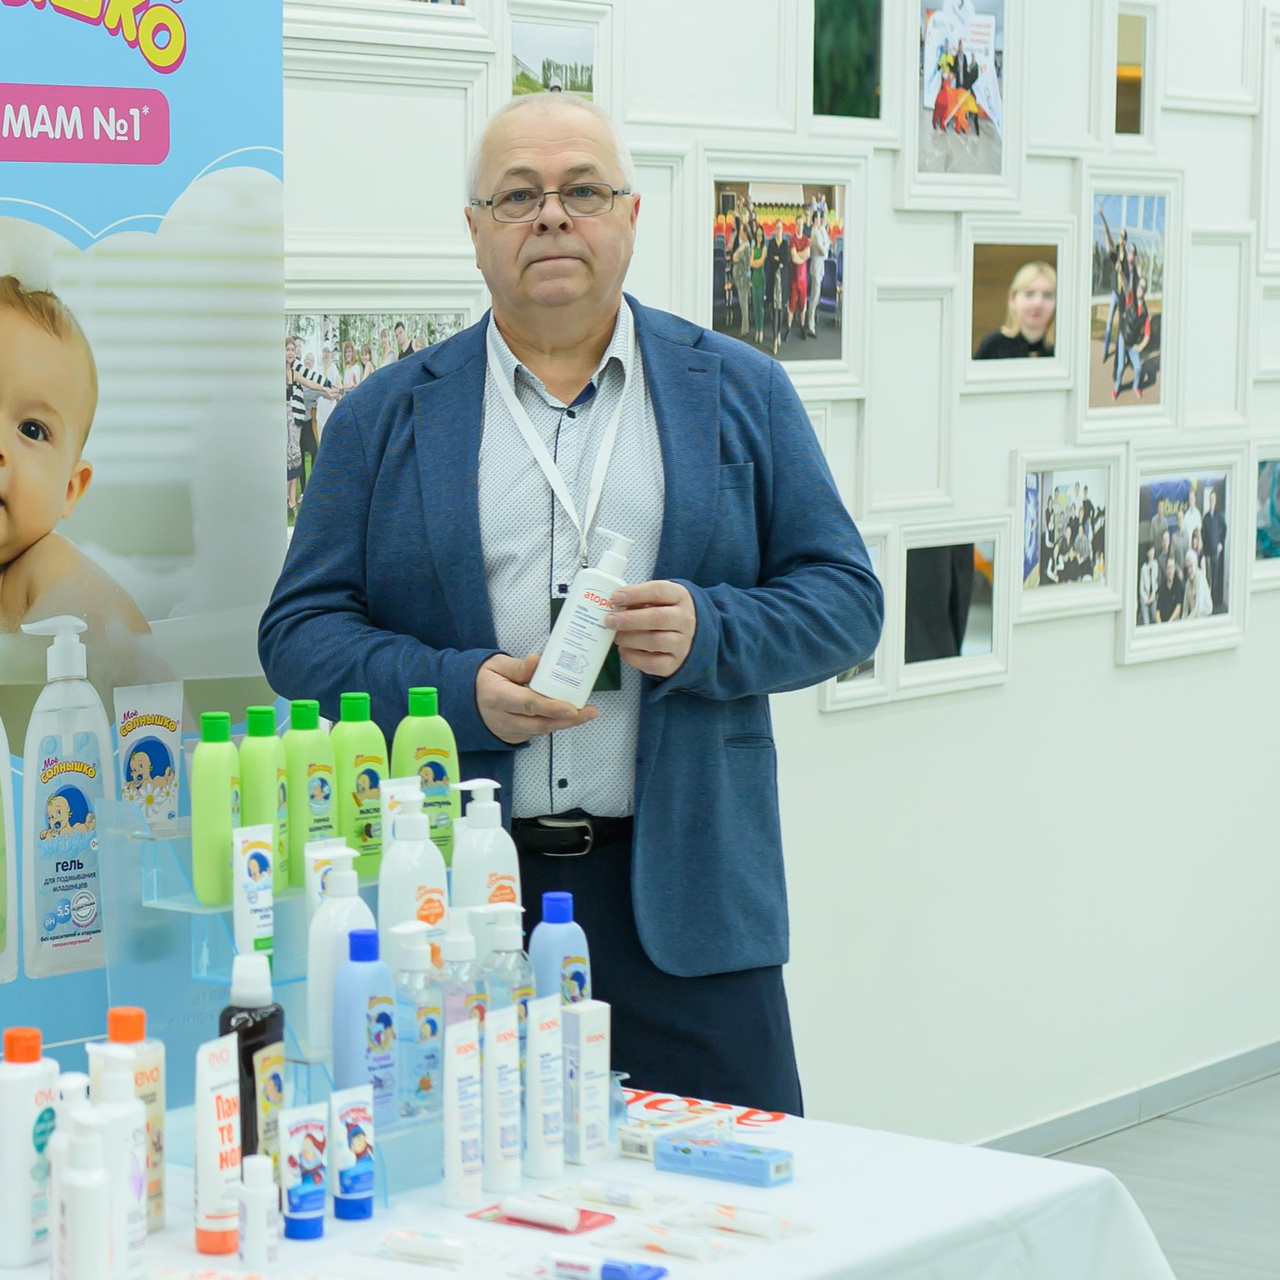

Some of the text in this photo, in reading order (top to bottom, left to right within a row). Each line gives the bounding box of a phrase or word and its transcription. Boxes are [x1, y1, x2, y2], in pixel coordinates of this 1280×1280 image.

[2, 103, 83, 140] МАМ
[55, 859, 84, 873] гель
[57, 904, 70, 916] 5,5
